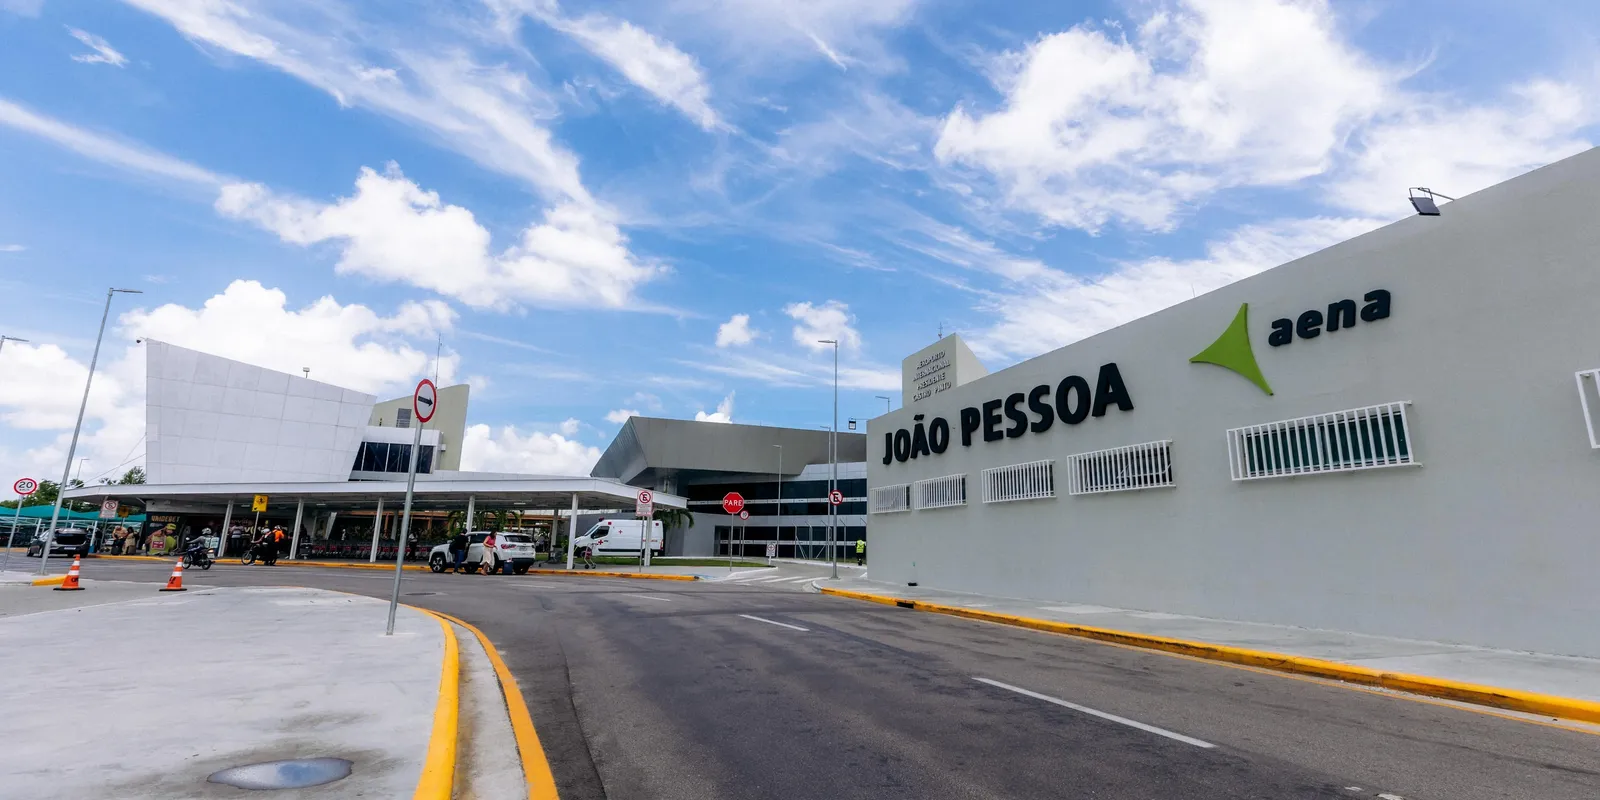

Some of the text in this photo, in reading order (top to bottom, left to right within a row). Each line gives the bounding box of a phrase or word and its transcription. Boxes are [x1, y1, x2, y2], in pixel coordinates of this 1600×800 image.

[1268, 289, 1391, 347] aena
[916, 350, 946, 370] AEROPORTO
[917, 372, 946, 390] PRESIDENTE
[913, 382, 952, 402] CASTRO PINTO
[883, 362, 1134, 466] JOÃO PESSOA
[724, 499, 743, 507] PARE
